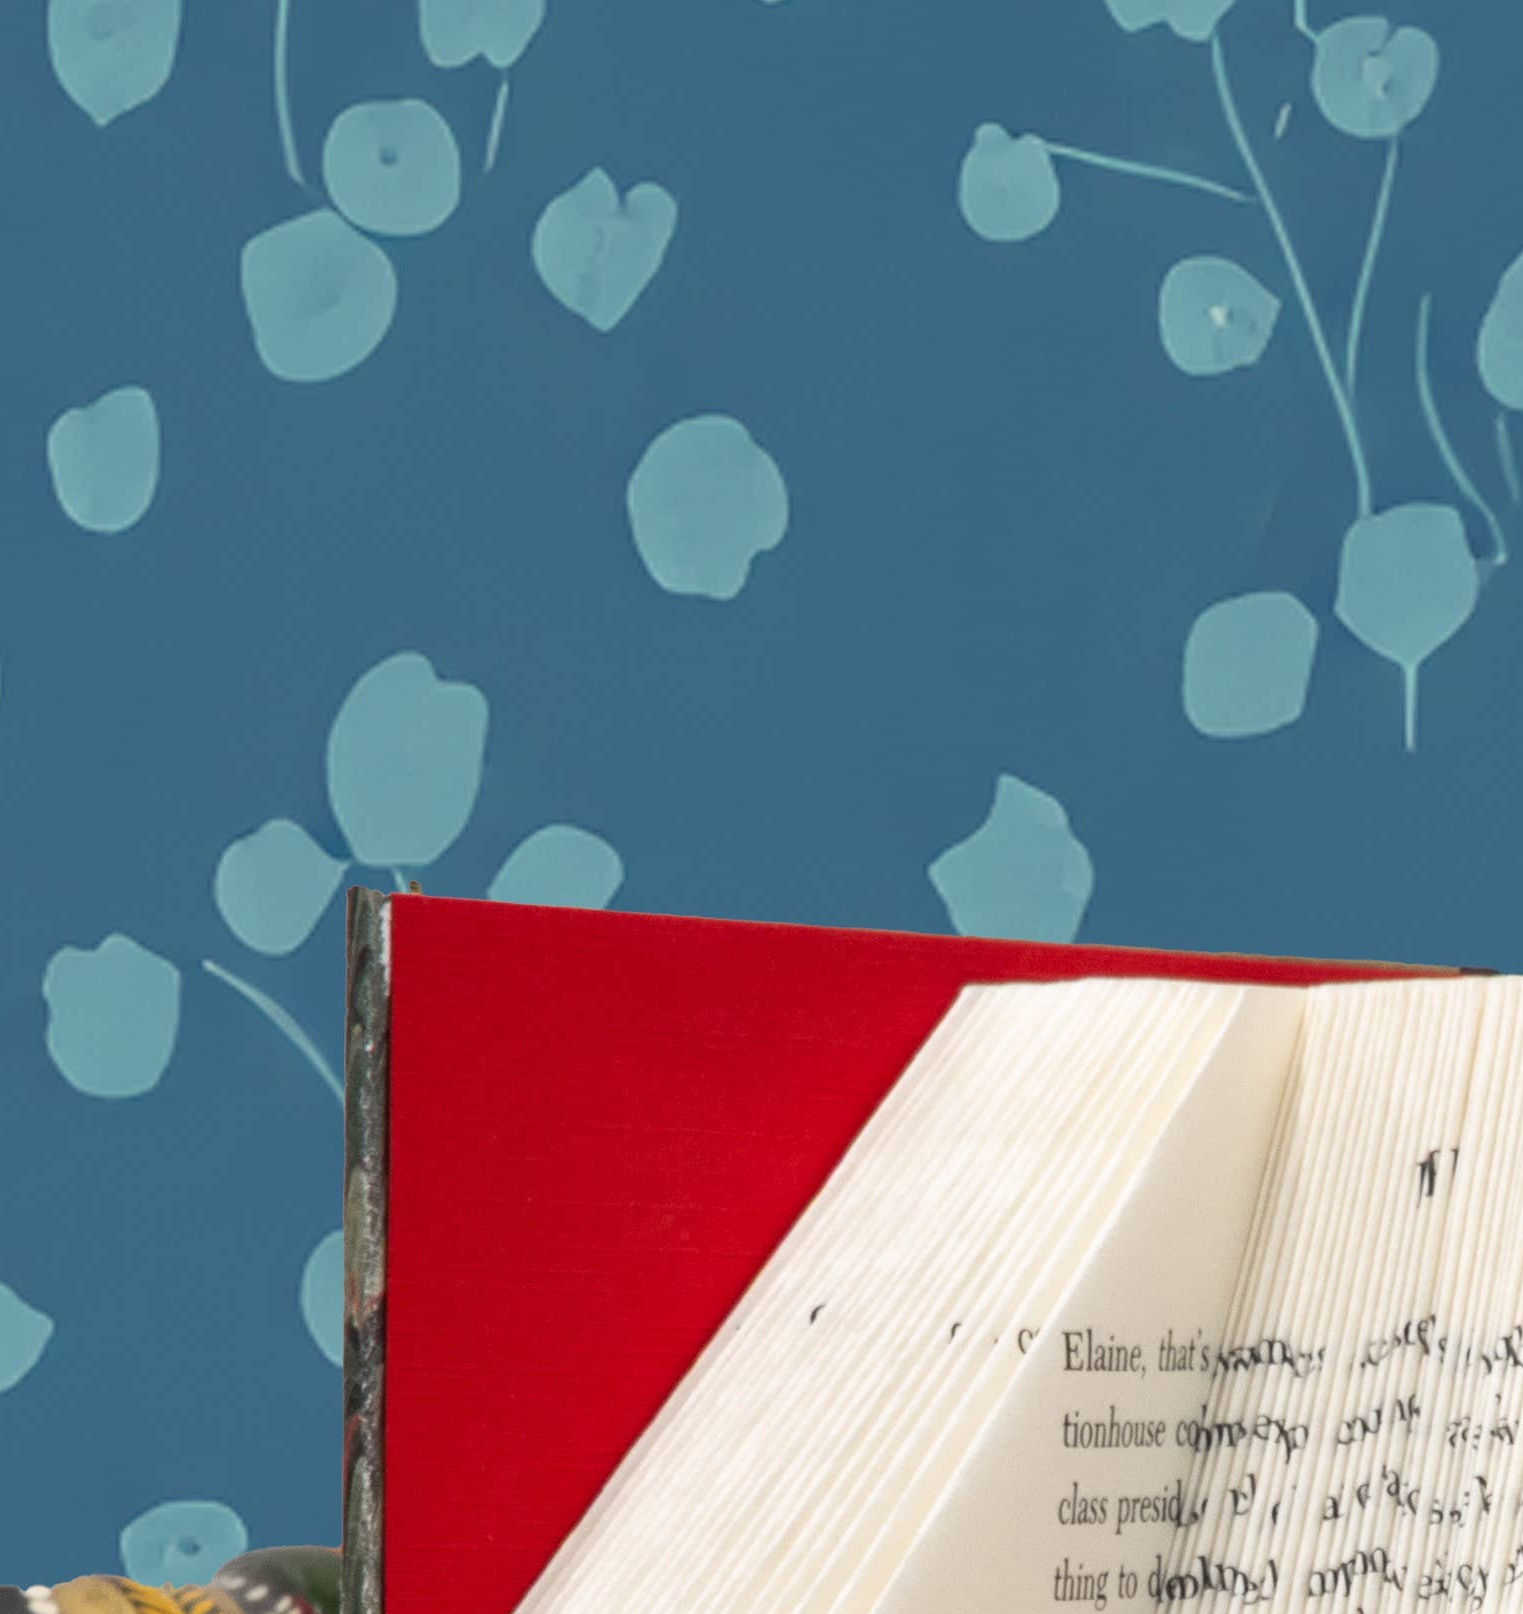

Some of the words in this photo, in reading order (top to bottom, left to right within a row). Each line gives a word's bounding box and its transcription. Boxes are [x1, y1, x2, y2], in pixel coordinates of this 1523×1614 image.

[1062, 1328, 1146, 1379] Elaine,
[1158, 1328, 1210, 1373] that's
[1062, 1404, 1167, 1450] tionhouse
[1058, 1481, 1109, 1526] class
[1054, 1557, 1110, 1612] thing
[1118, 1564, 1138, 1600] to
